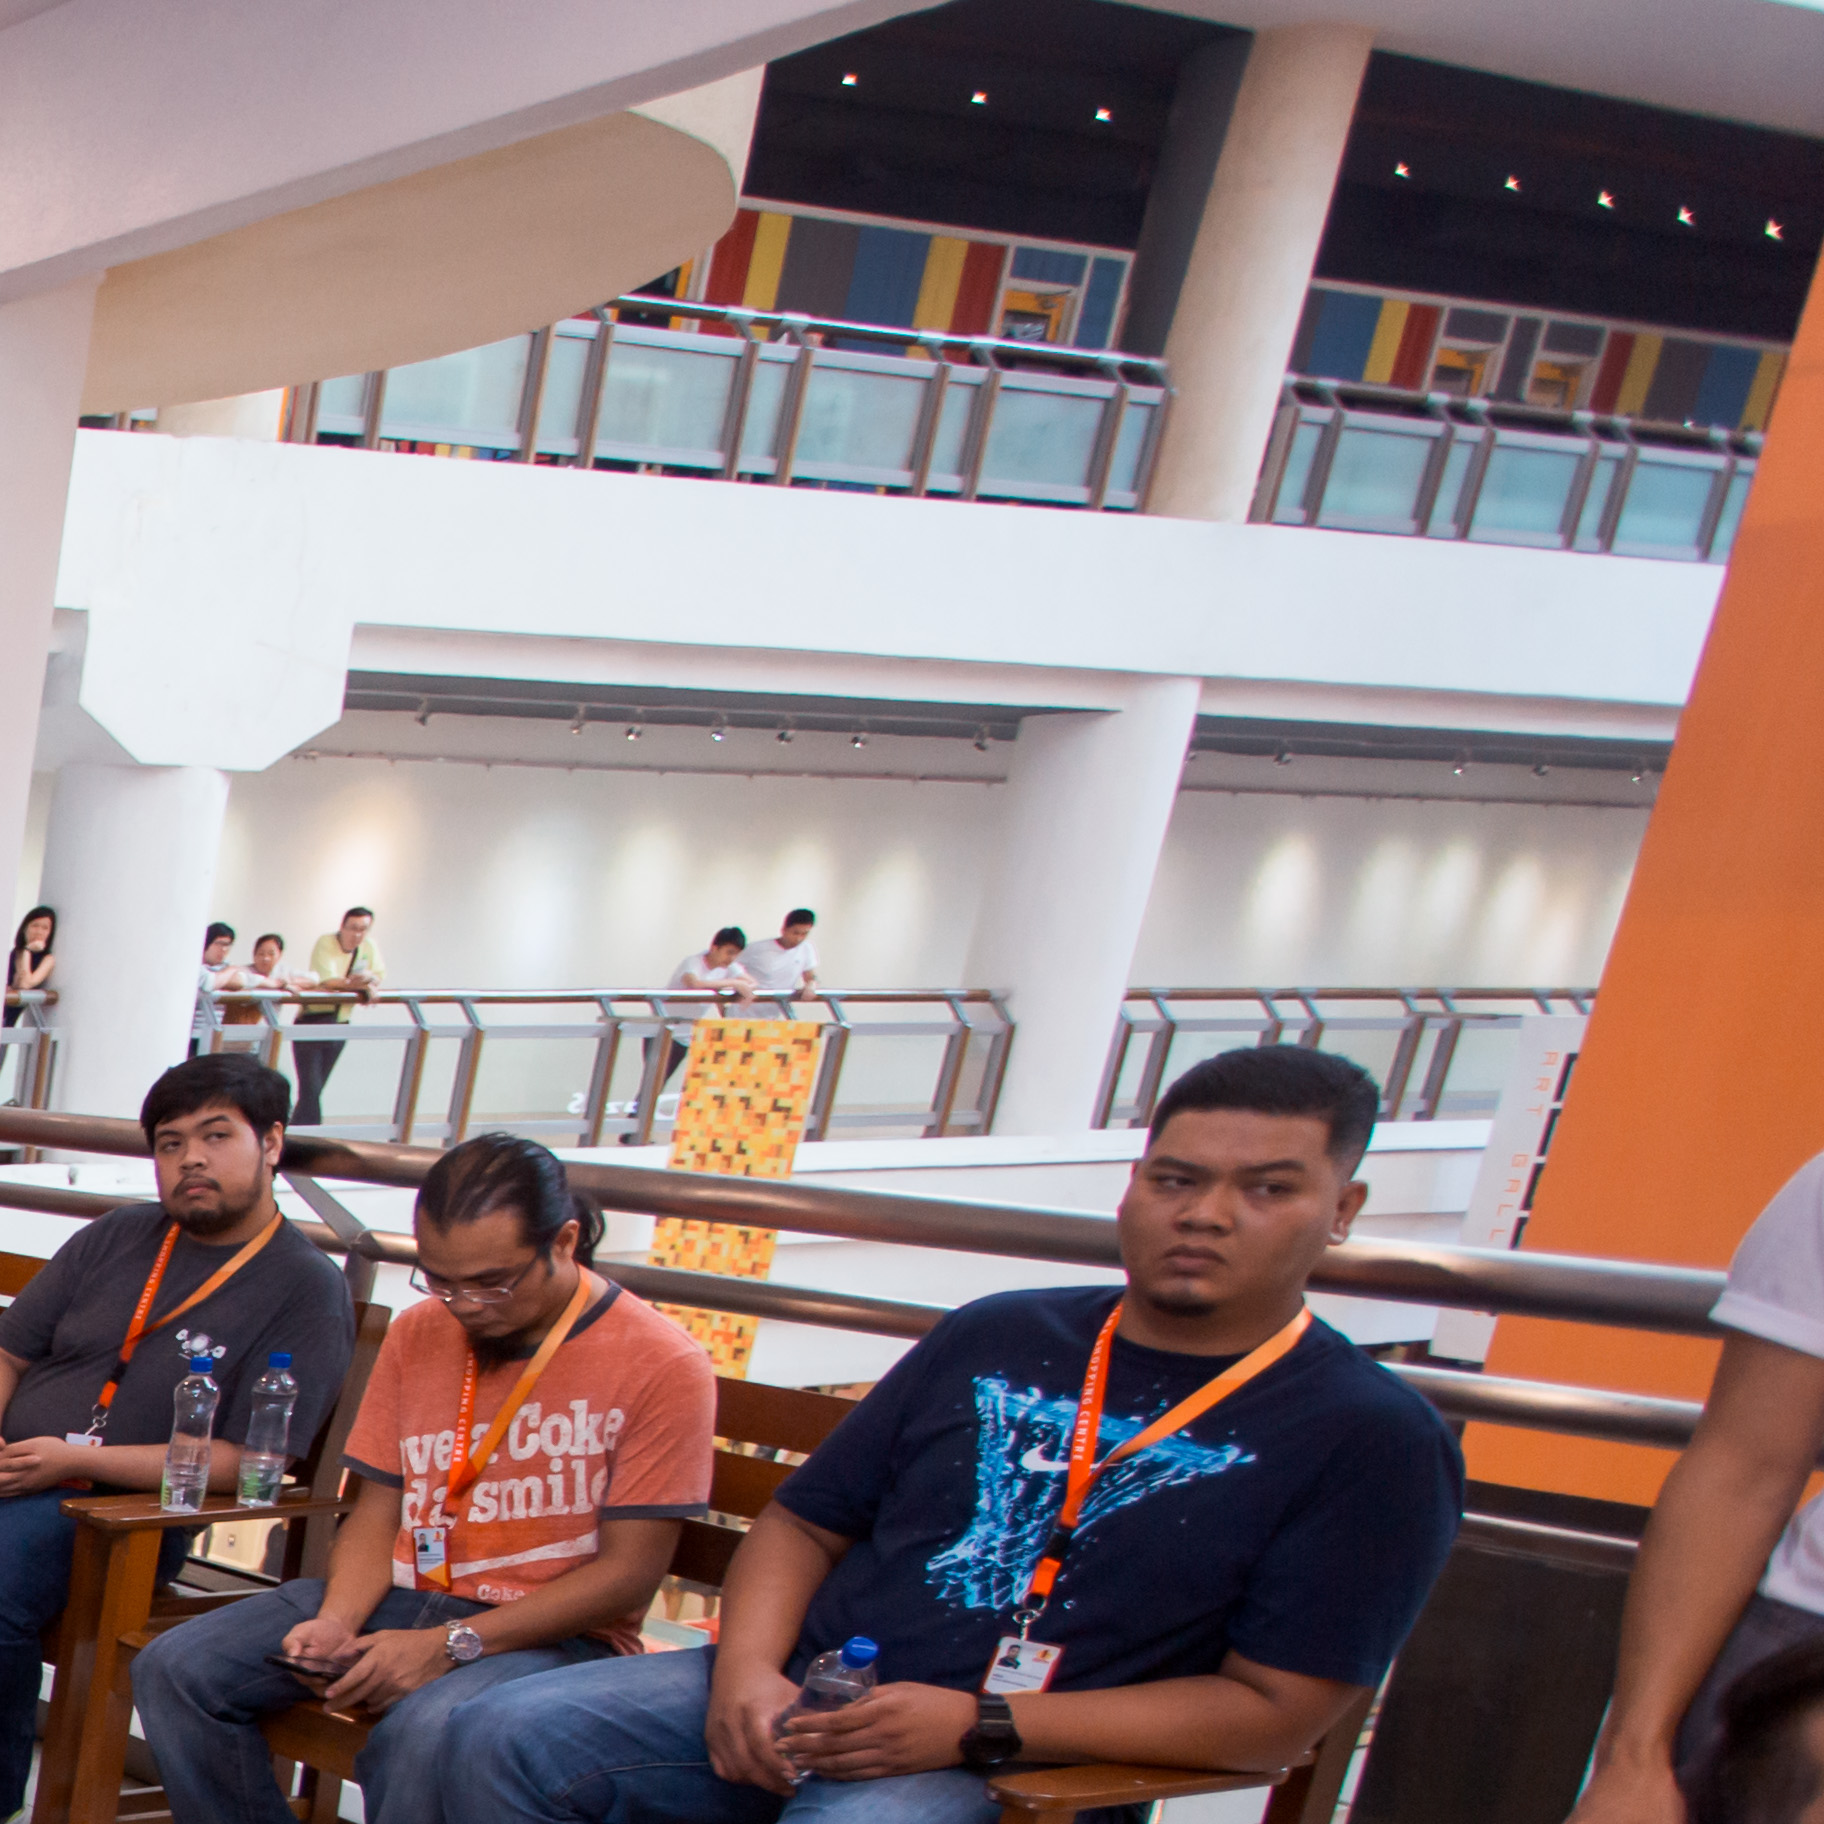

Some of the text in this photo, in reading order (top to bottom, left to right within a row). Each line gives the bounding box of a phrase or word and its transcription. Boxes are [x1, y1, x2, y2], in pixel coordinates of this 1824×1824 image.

[453, 1418, 467, 1462] CENTRE
[509, 1399, 625, 1460] Coke
[1072, 1410, 1091, 1461] CENTRE
